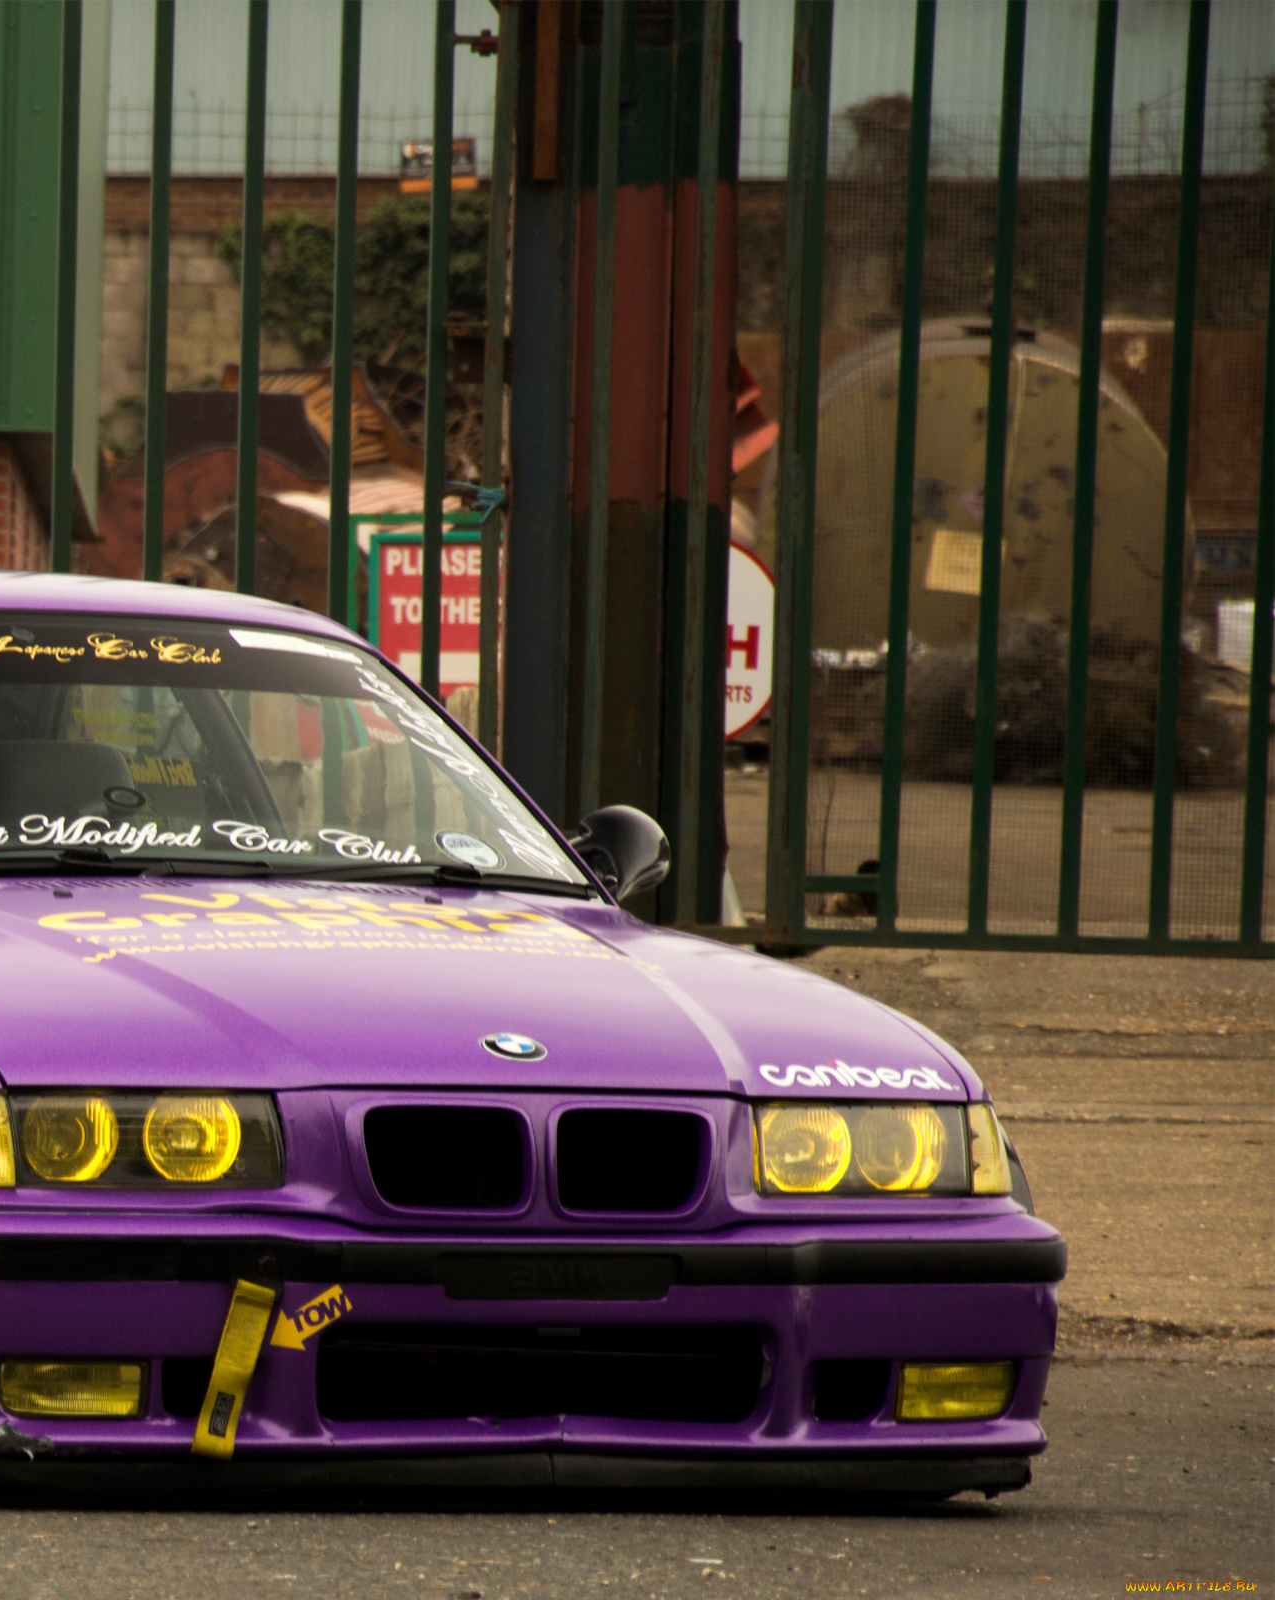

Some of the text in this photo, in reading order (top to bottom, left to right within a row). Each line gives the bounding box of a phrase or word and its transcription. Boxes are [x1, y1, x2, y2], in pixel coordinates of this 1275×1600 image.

[389, 595, 423, 625] TO
[86, 632, 149, 660] Car
[150, 635, 223, 665] Club
[18, 813, 203, 854] Modified
[212, 819, 313, 855] Car
[316, 828, 422, 864] Club
[139, 892, 553, 924] Vision
[37, 911, 594, 942] Graphics
[759, 1059, 955, 1092] canibeat
[287, 1291, 351, 1333] TOW
